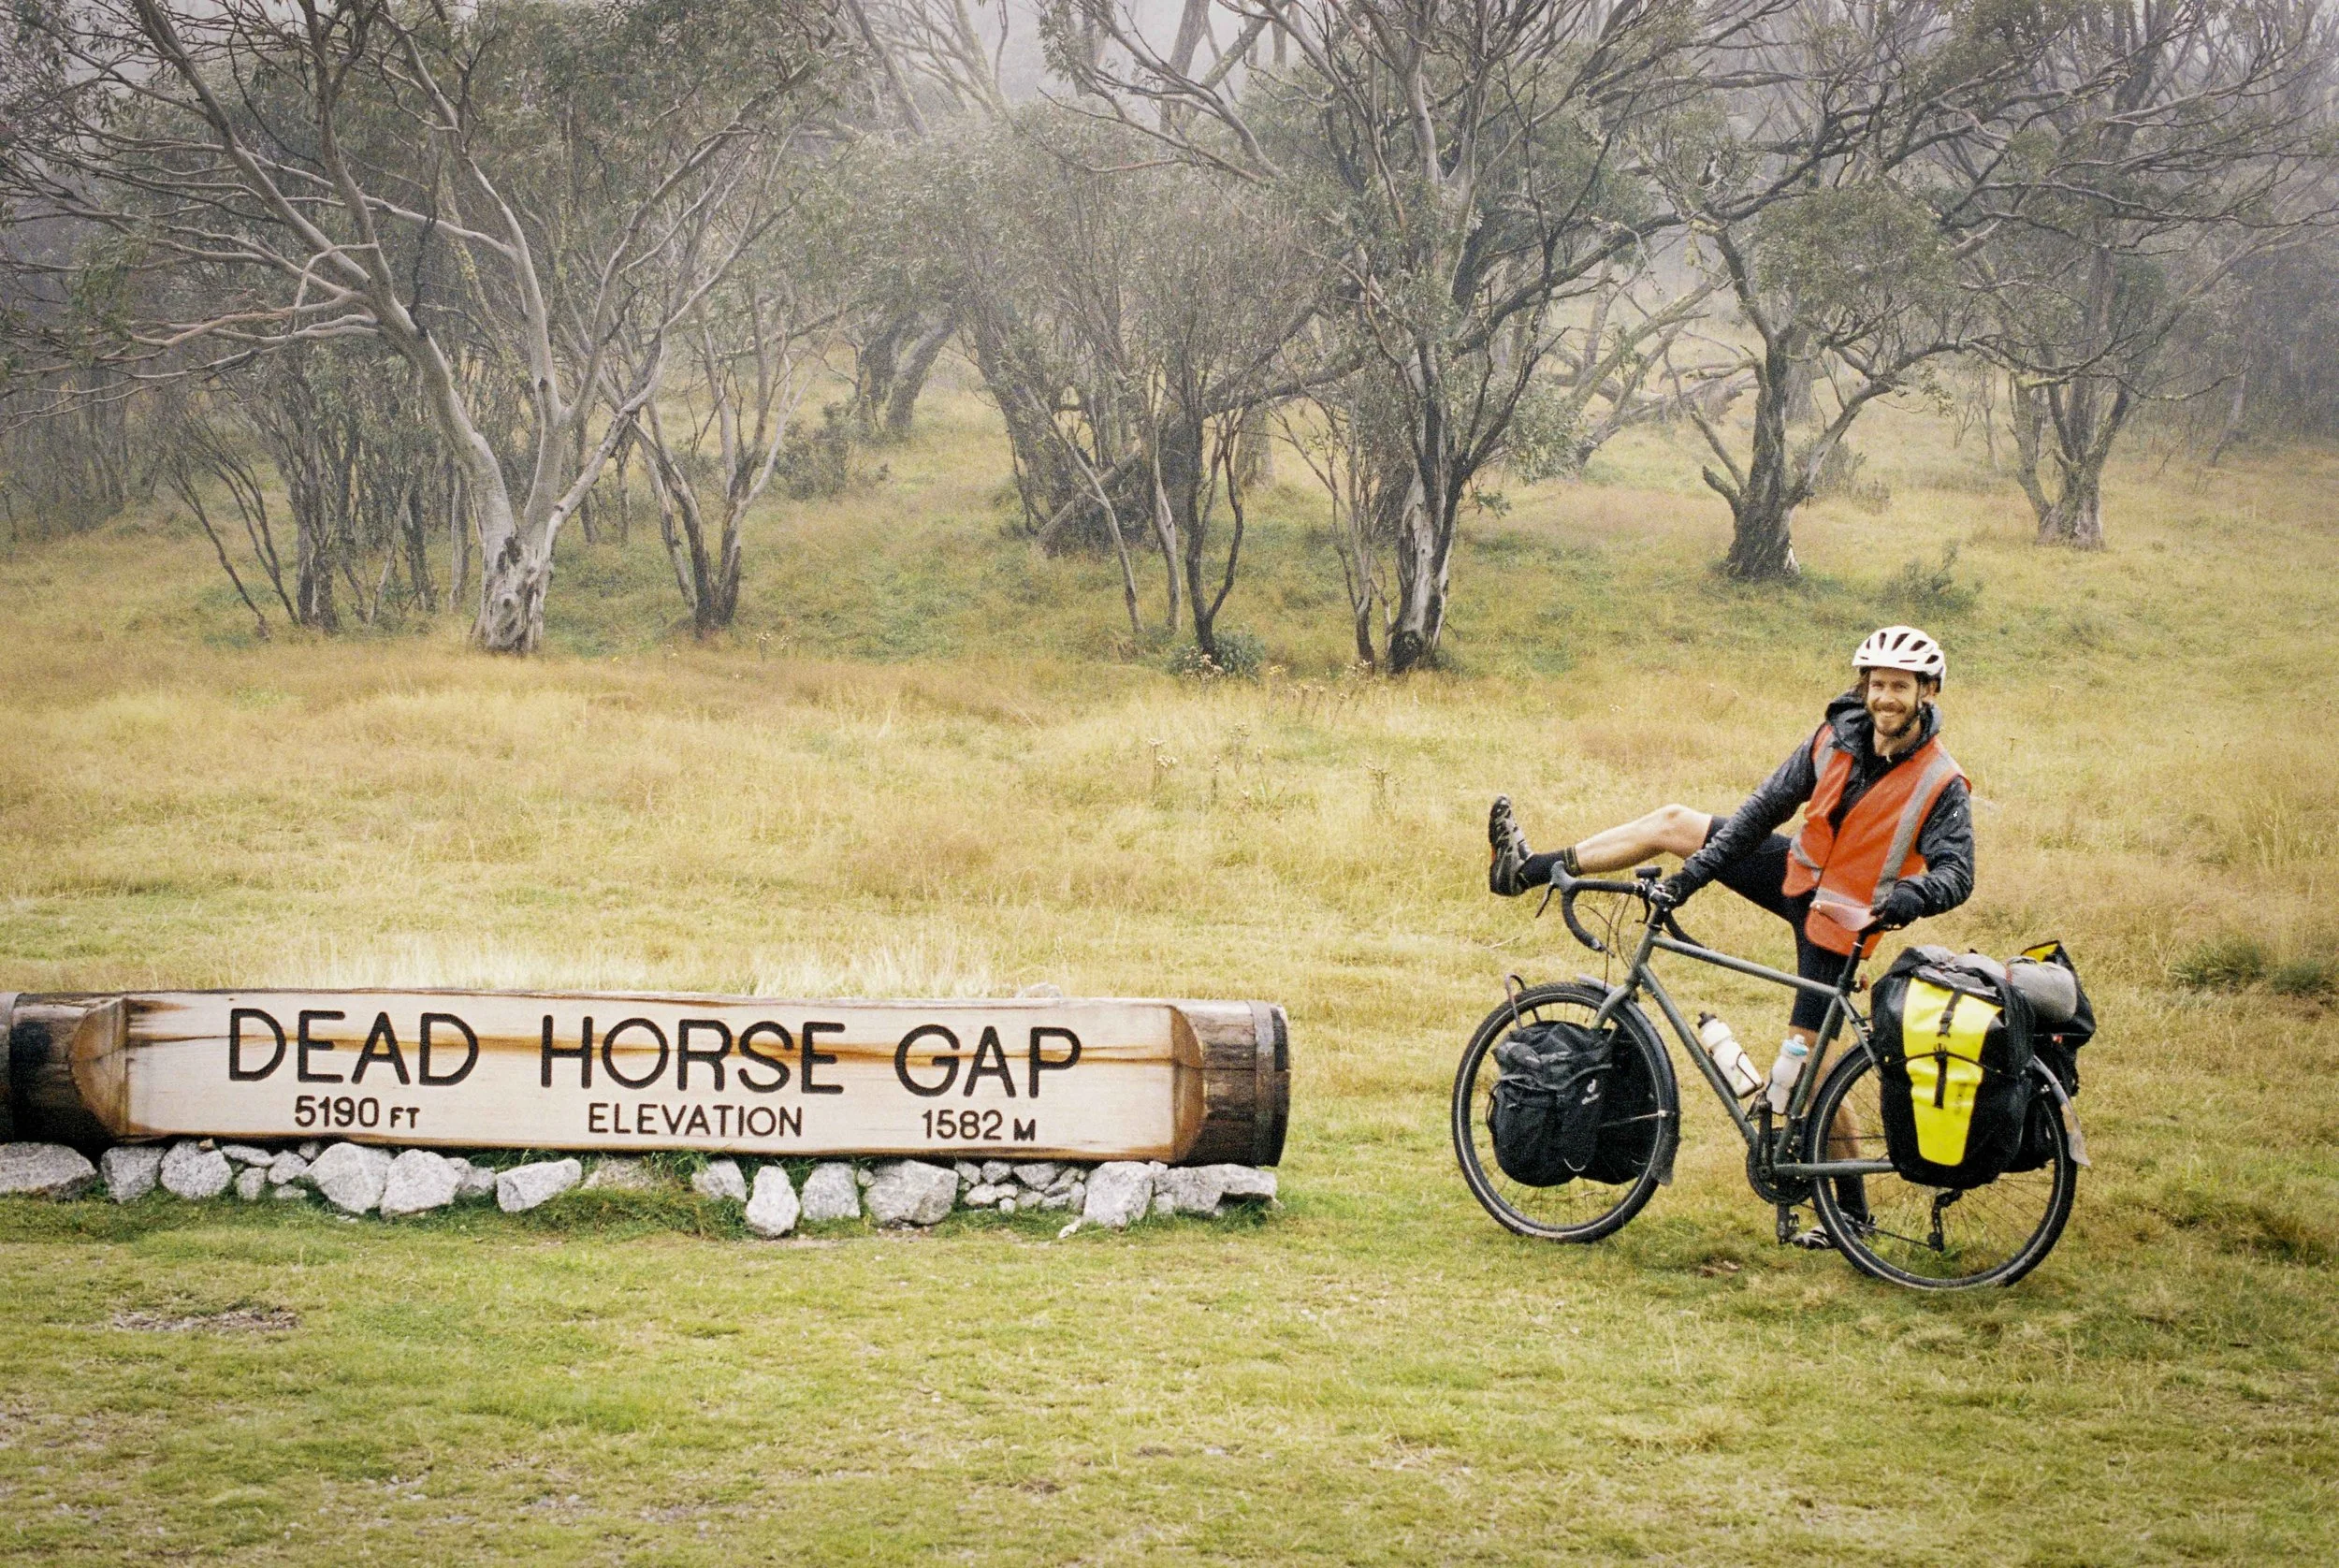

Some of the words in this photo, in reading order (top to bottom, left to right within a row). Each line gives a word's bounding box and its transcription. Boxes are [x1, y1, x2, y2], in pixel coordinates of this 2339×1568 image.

[227, 1008, 479, 1086] DEAD
[541, 1014, 846, 1095] HORSE
[893, 1024, 1082, 1098] GAP
[295, 1095, 380, 1127] 5190
[390, 1107, 420, 1128] FT
[588, 1102, 803, 1137] ELEVATION
[923, 1110, 1003, 1140] 1582
[1013, 1118, 1036, 1141] M
